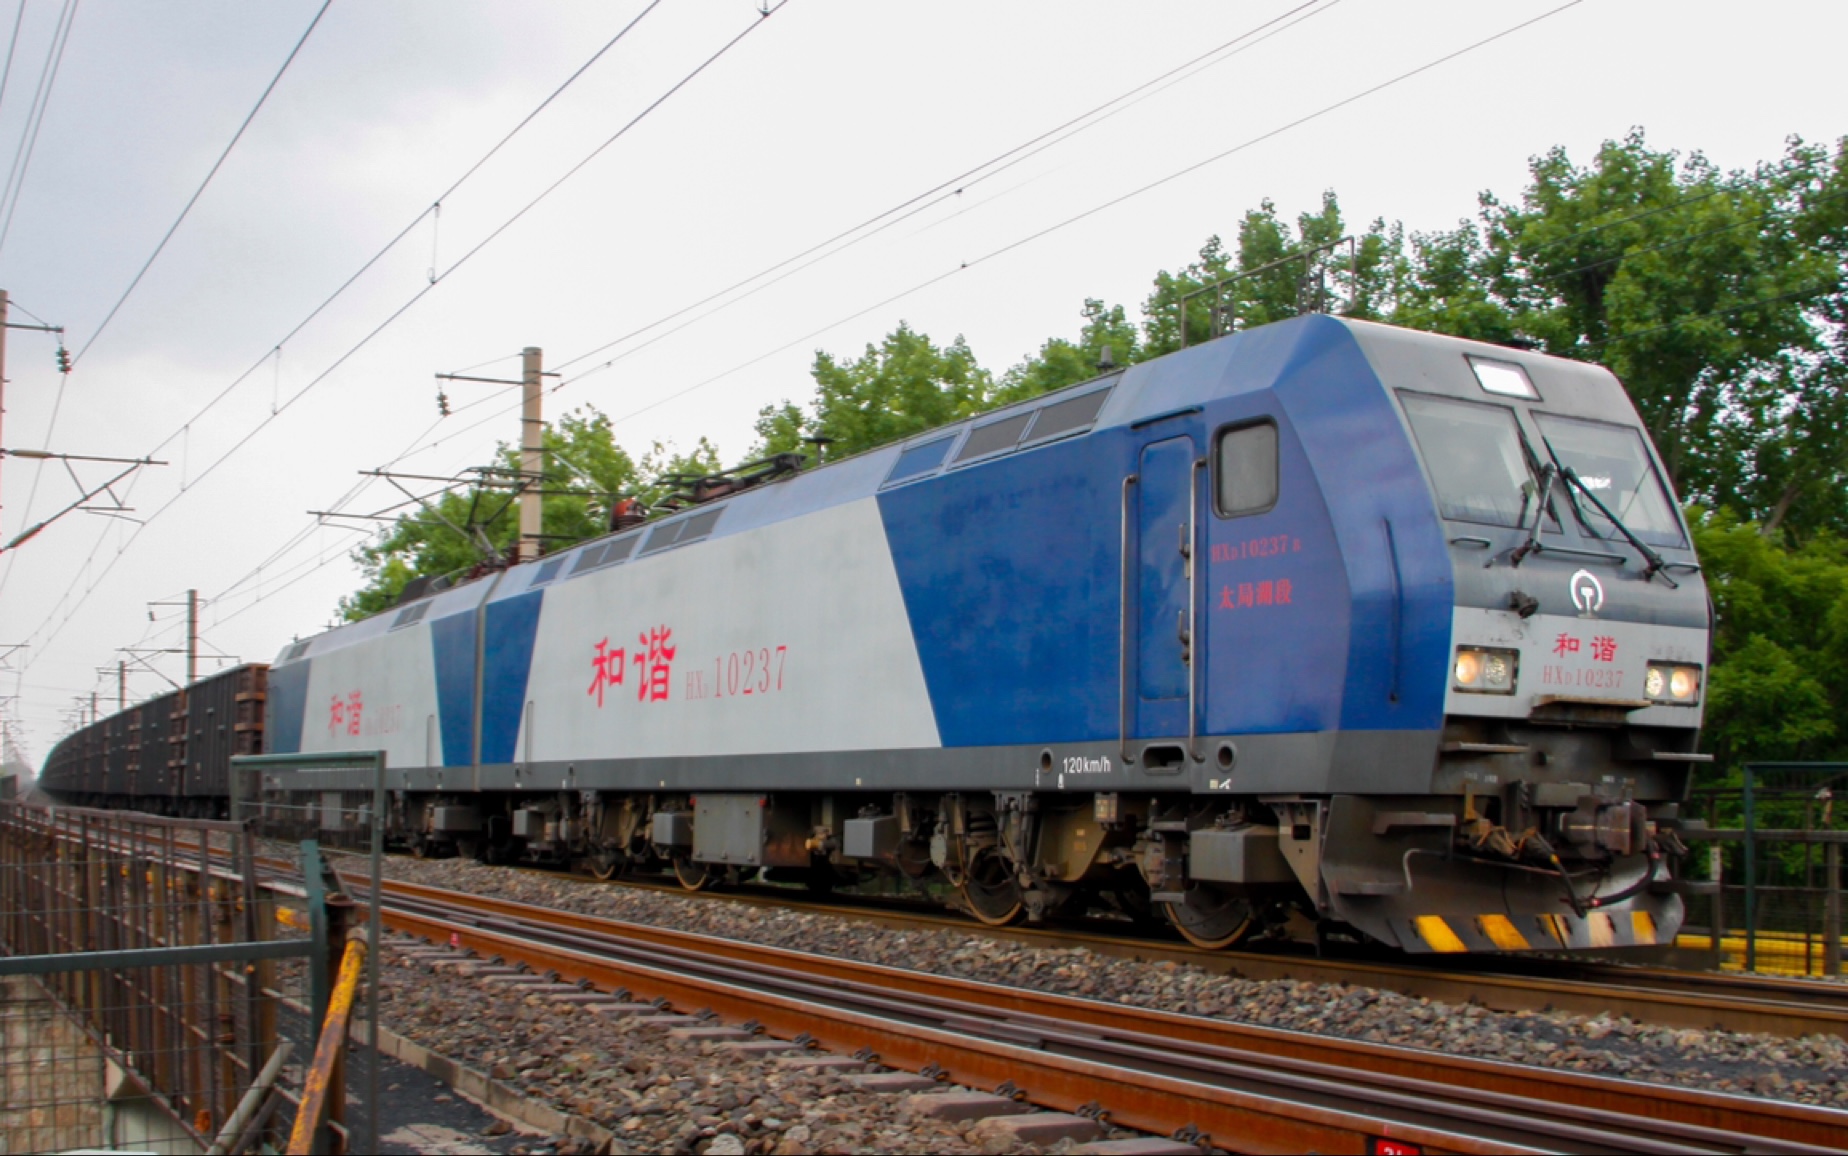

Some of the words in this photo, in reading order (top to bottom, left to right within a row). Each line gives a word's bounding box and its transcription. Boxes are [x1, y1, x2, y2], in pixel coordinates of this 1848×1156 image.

[1552, 632, 1618, 662] 和谐
[587, 624, 677, 708] 和谐
[1542, 664, 1624, 689] HXD10237
[1062, 756, 1111, 774] 120km/h
